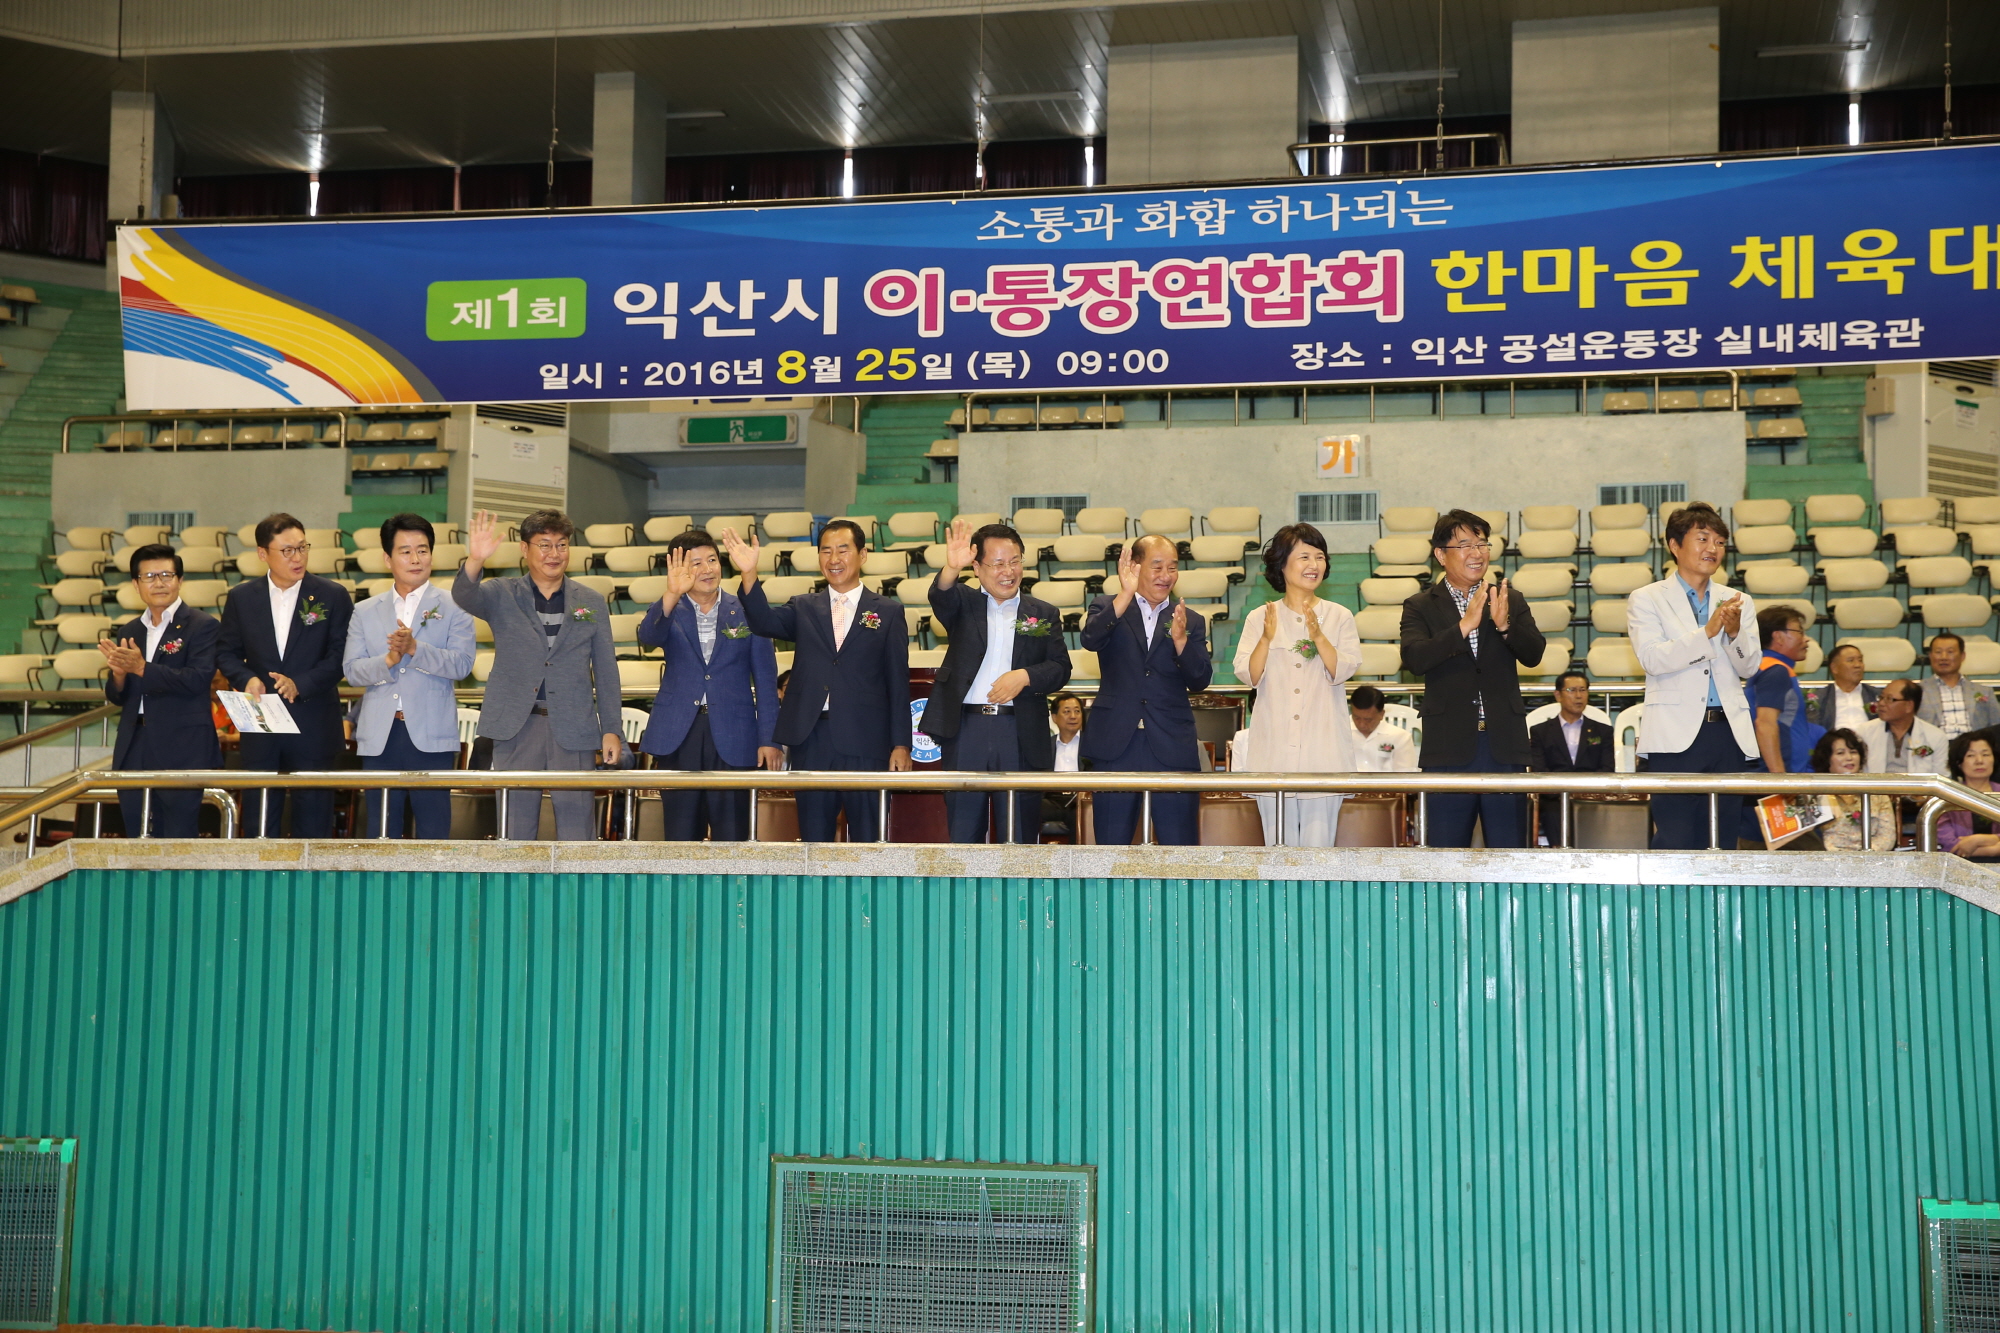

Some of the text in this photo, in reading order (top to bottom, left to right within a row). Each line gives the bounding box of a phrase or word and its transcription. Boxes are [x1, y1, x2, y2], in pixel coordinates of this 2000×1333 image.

[976, 188, 1454, 243] 소통과 화합 하나되는
[613, 276, 839, 340] 익산시
[1430, 240, 1700, 313] 한마음
[1729, 224, 2000, 299] 체육대
[450, 287, 567, 330] 제1회
[1290, 341, 1365, 371] 장소
[1411, 335, 1488, 366] 익산
[1499, 327, 1702, 364] 공설운동장
[1714, 317, 1925, 356] 실내체육관
[539, 362, 603, 390] 일시
[643, 358, 763, 386] 2016년
[776, 349, 842, 385] 8월
[852, 347, 953, 382] 25일
[967, 349, 1031, 380] (목)
[1056, 348, 1169, 376] 09:00
[1321, 440, 1356, 474] 가
